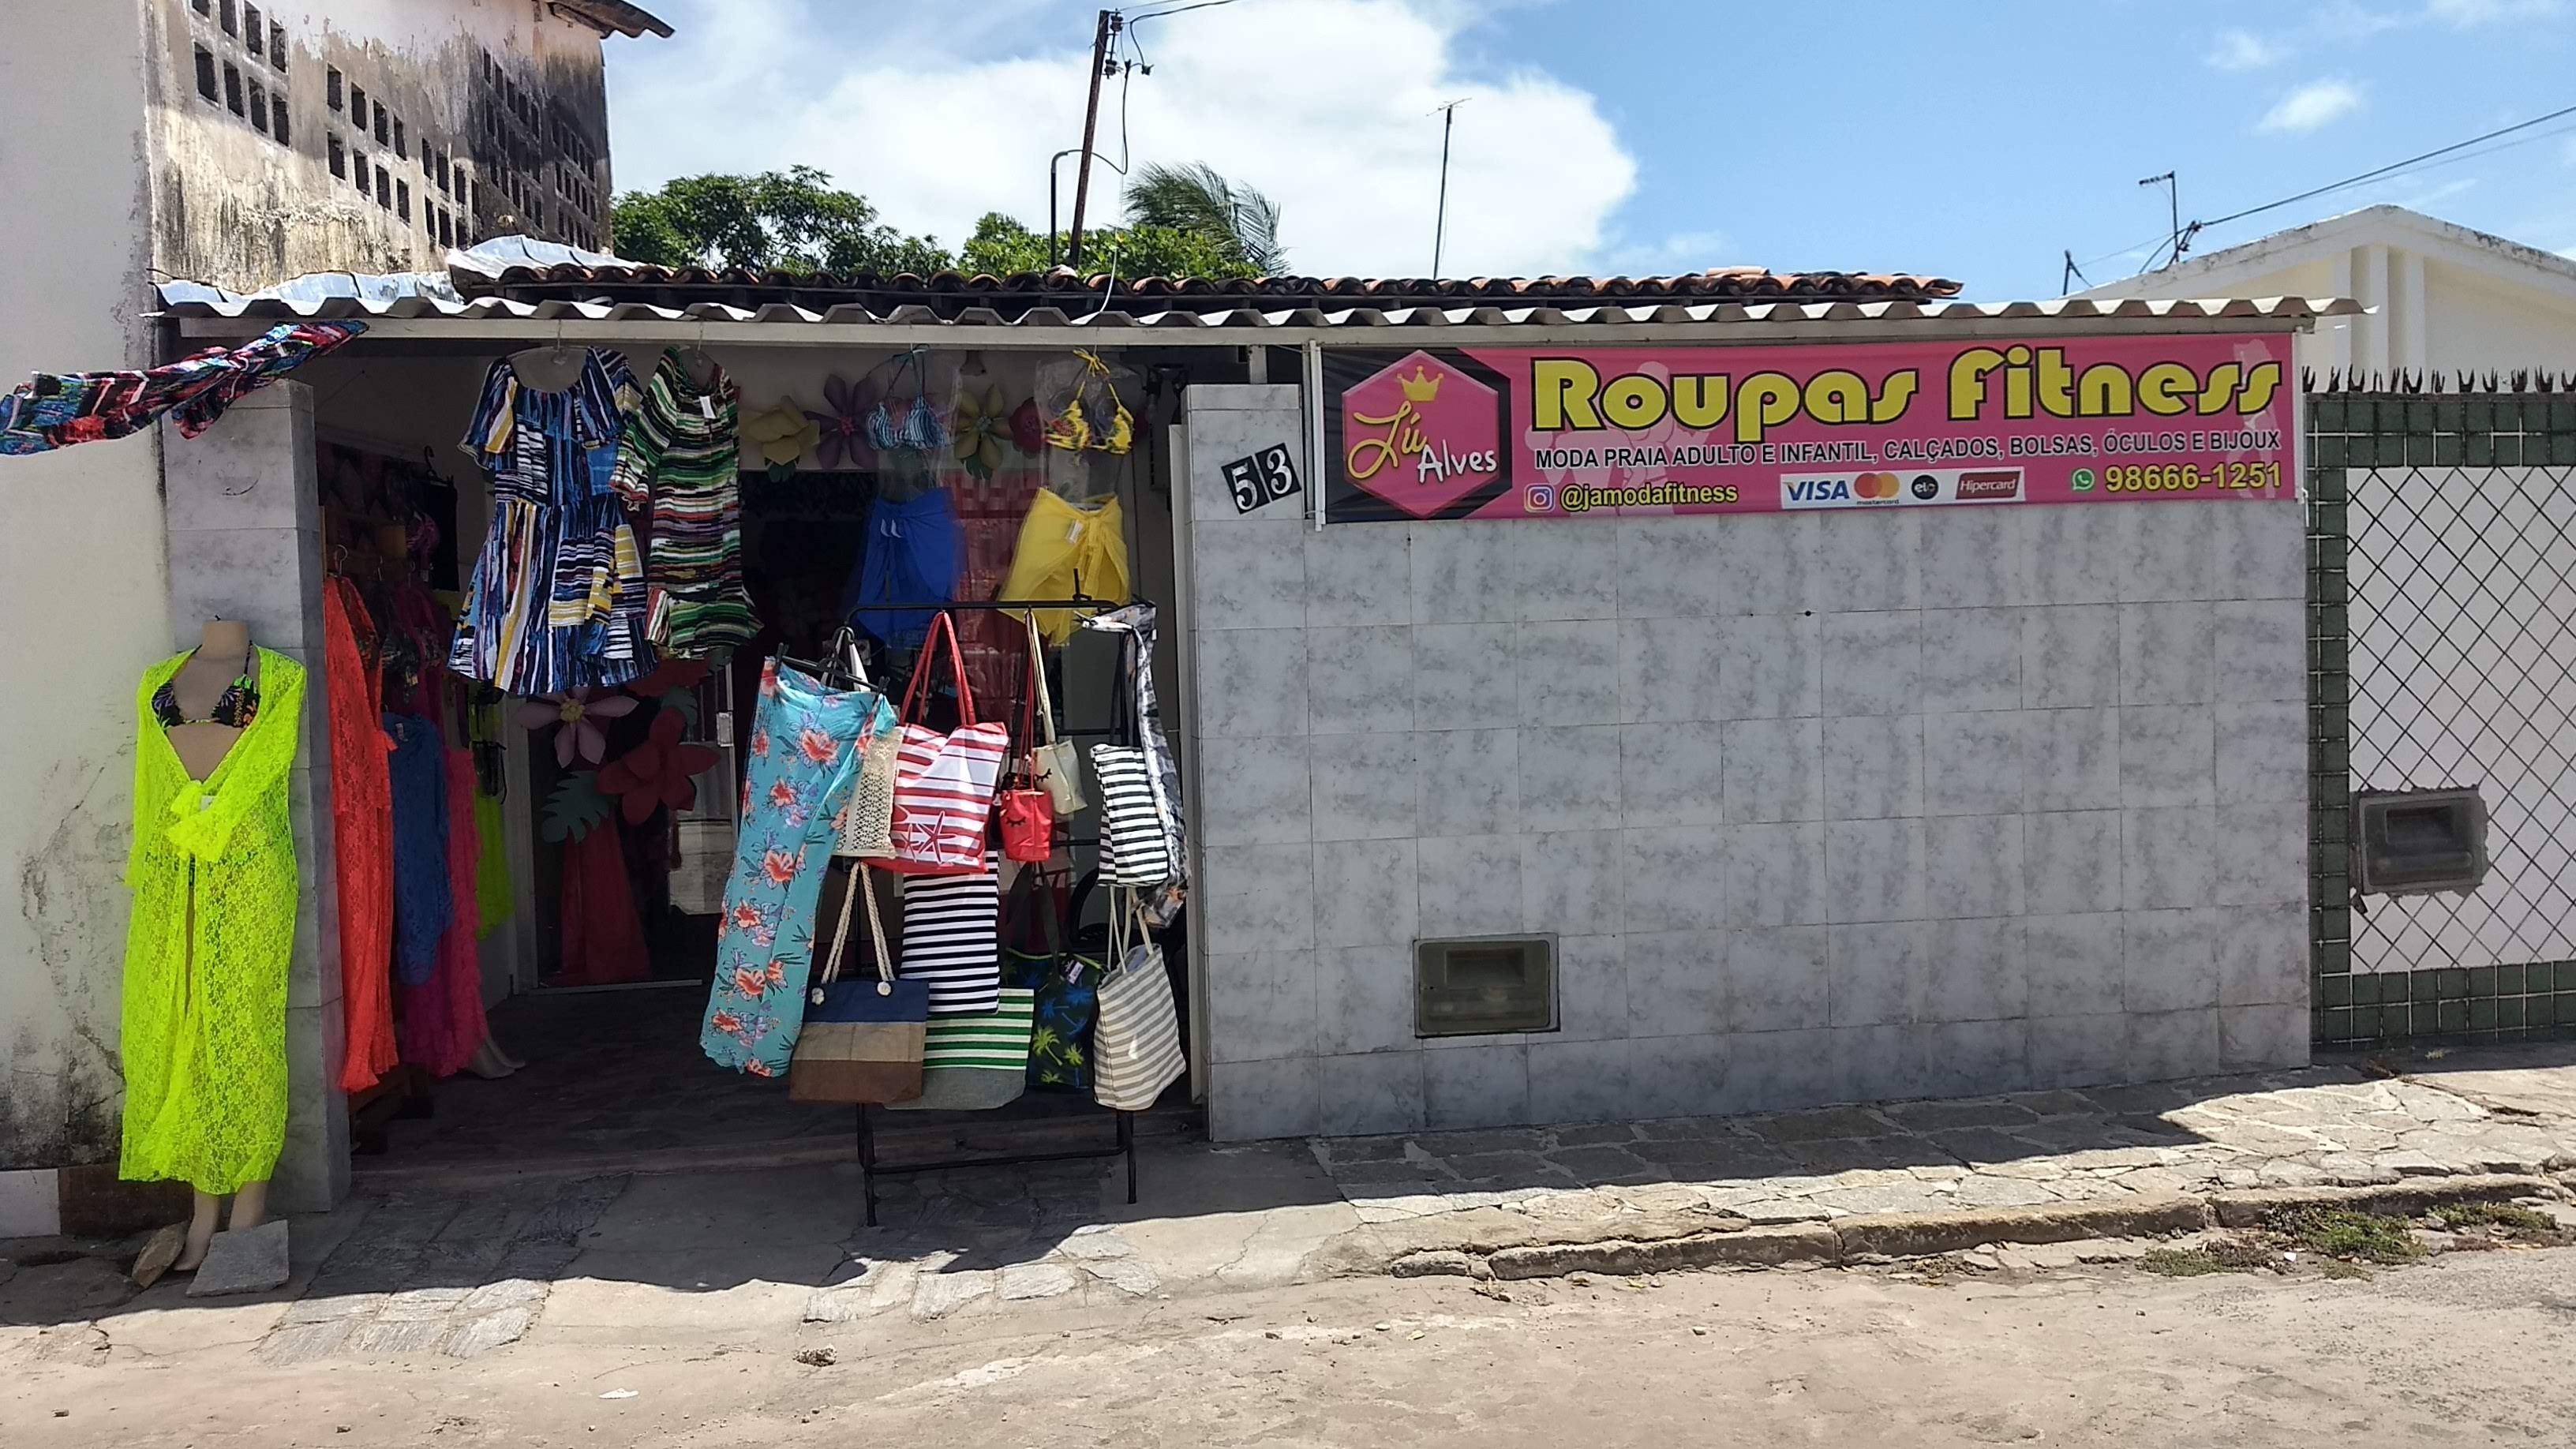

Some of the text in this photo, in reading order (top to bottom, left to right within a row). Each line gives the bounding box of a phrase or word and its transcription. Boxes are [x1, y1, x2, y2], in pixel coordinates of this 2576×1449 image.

[1530, 356, 1919, 444] Roupas
[1348, 400, 1428, 479] Lú
[1535, 429, 2281, 468] MODA PRAIA ADULTO E INFANTIL, CALÇADOS, BOLSAS, ÓCULOS E BIJOUX
[1230, 447, 1294, 511] 53
[1417, 439, 1497, 484] Alves
[2104, 462, 2282, 492] 98666-1251
[1560, 484, 1739, 511] @jamodafitness
[1783, 480, 1851, 501] VISA
[1960, 477, 2017, 494] Hipercard
